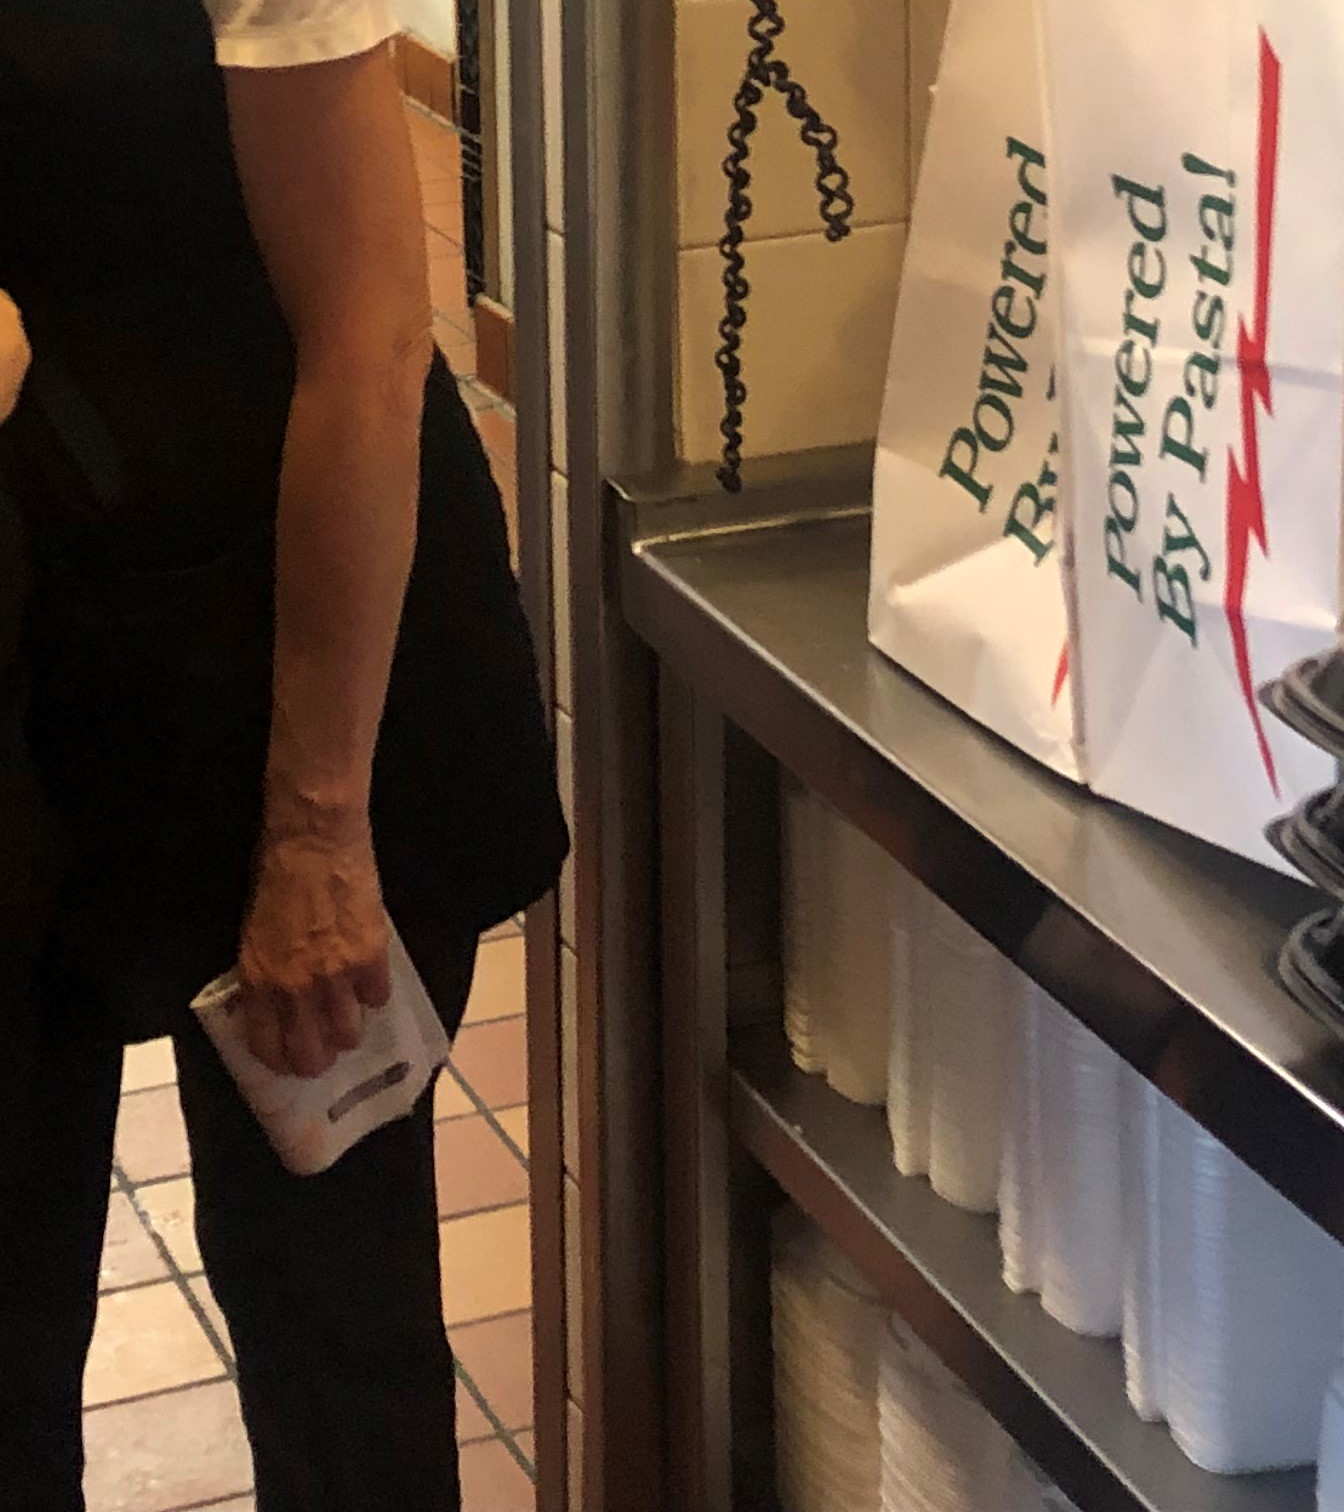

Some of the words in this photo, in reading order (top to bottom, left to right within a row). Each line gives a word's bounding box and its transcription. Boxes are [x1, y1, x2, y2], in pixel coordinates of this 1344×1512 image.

[1103, 173, 1167, 603] Powered
[1158, 151, 1238, 484] Pasta!
[1149, 491, 1212, 647] By
